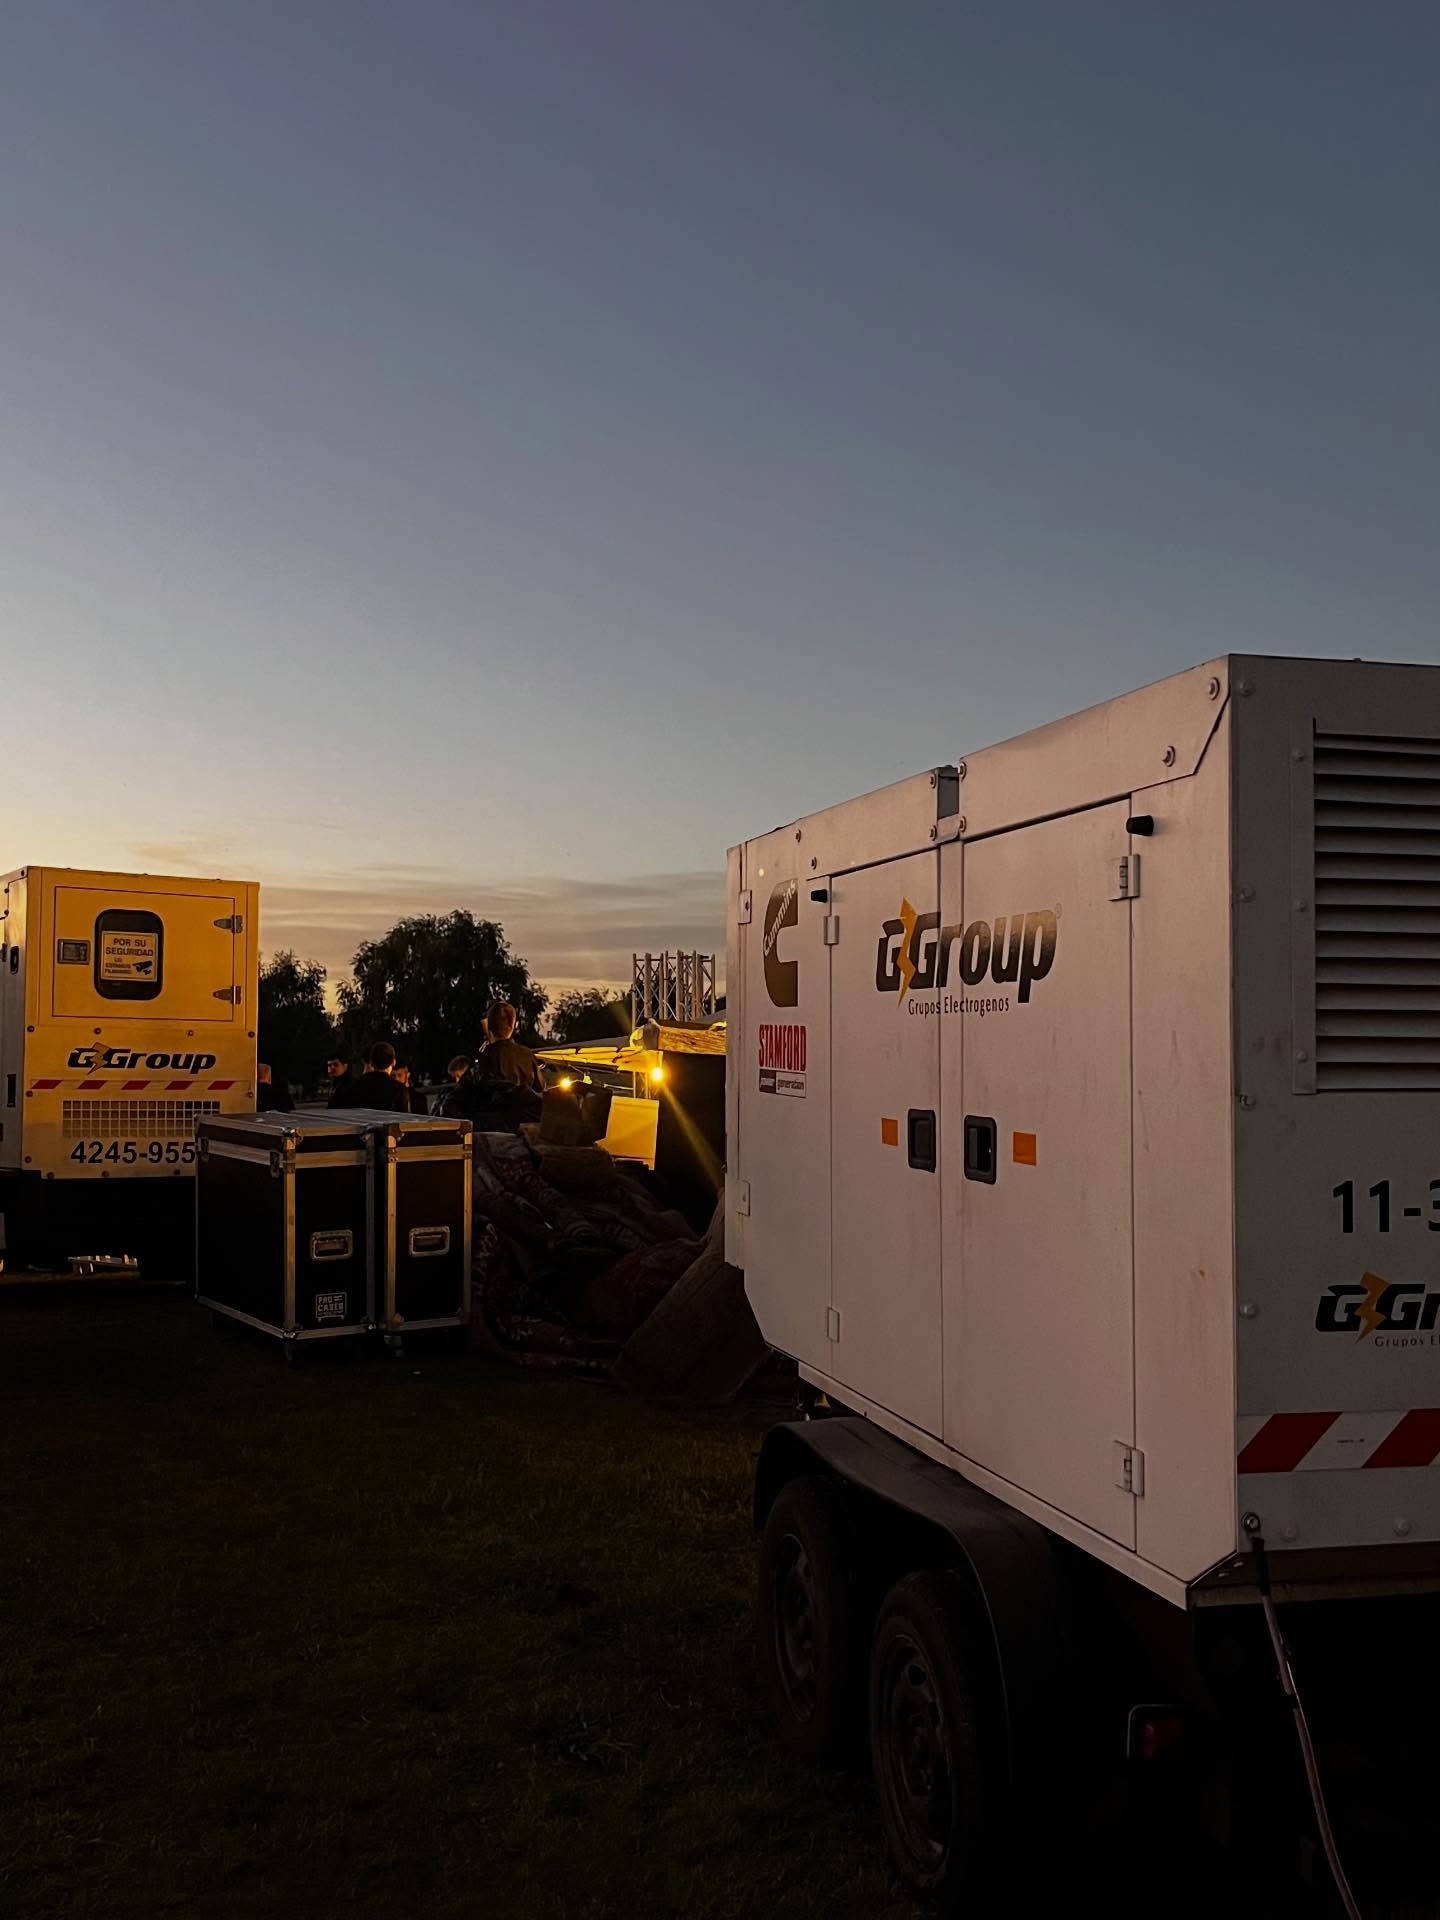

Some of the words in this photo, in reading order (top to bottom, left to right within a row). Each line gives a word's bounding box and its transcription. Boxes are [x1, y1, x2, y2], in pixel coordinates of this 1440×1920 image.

[762, 879, 796, 956] Cummins
[105, 946, 153, 956] SEGURIDAD
[113, 938, 131, 947] POR
[134, 939, 146, 947] SU
[908, 998, 941, 1019] Grupos
[944, 995, 1009, 1017] Electrogenos
[759, 1024, 806, 1071] STAMFORD
[1375, 1336, 1424, 1348] Grupos
